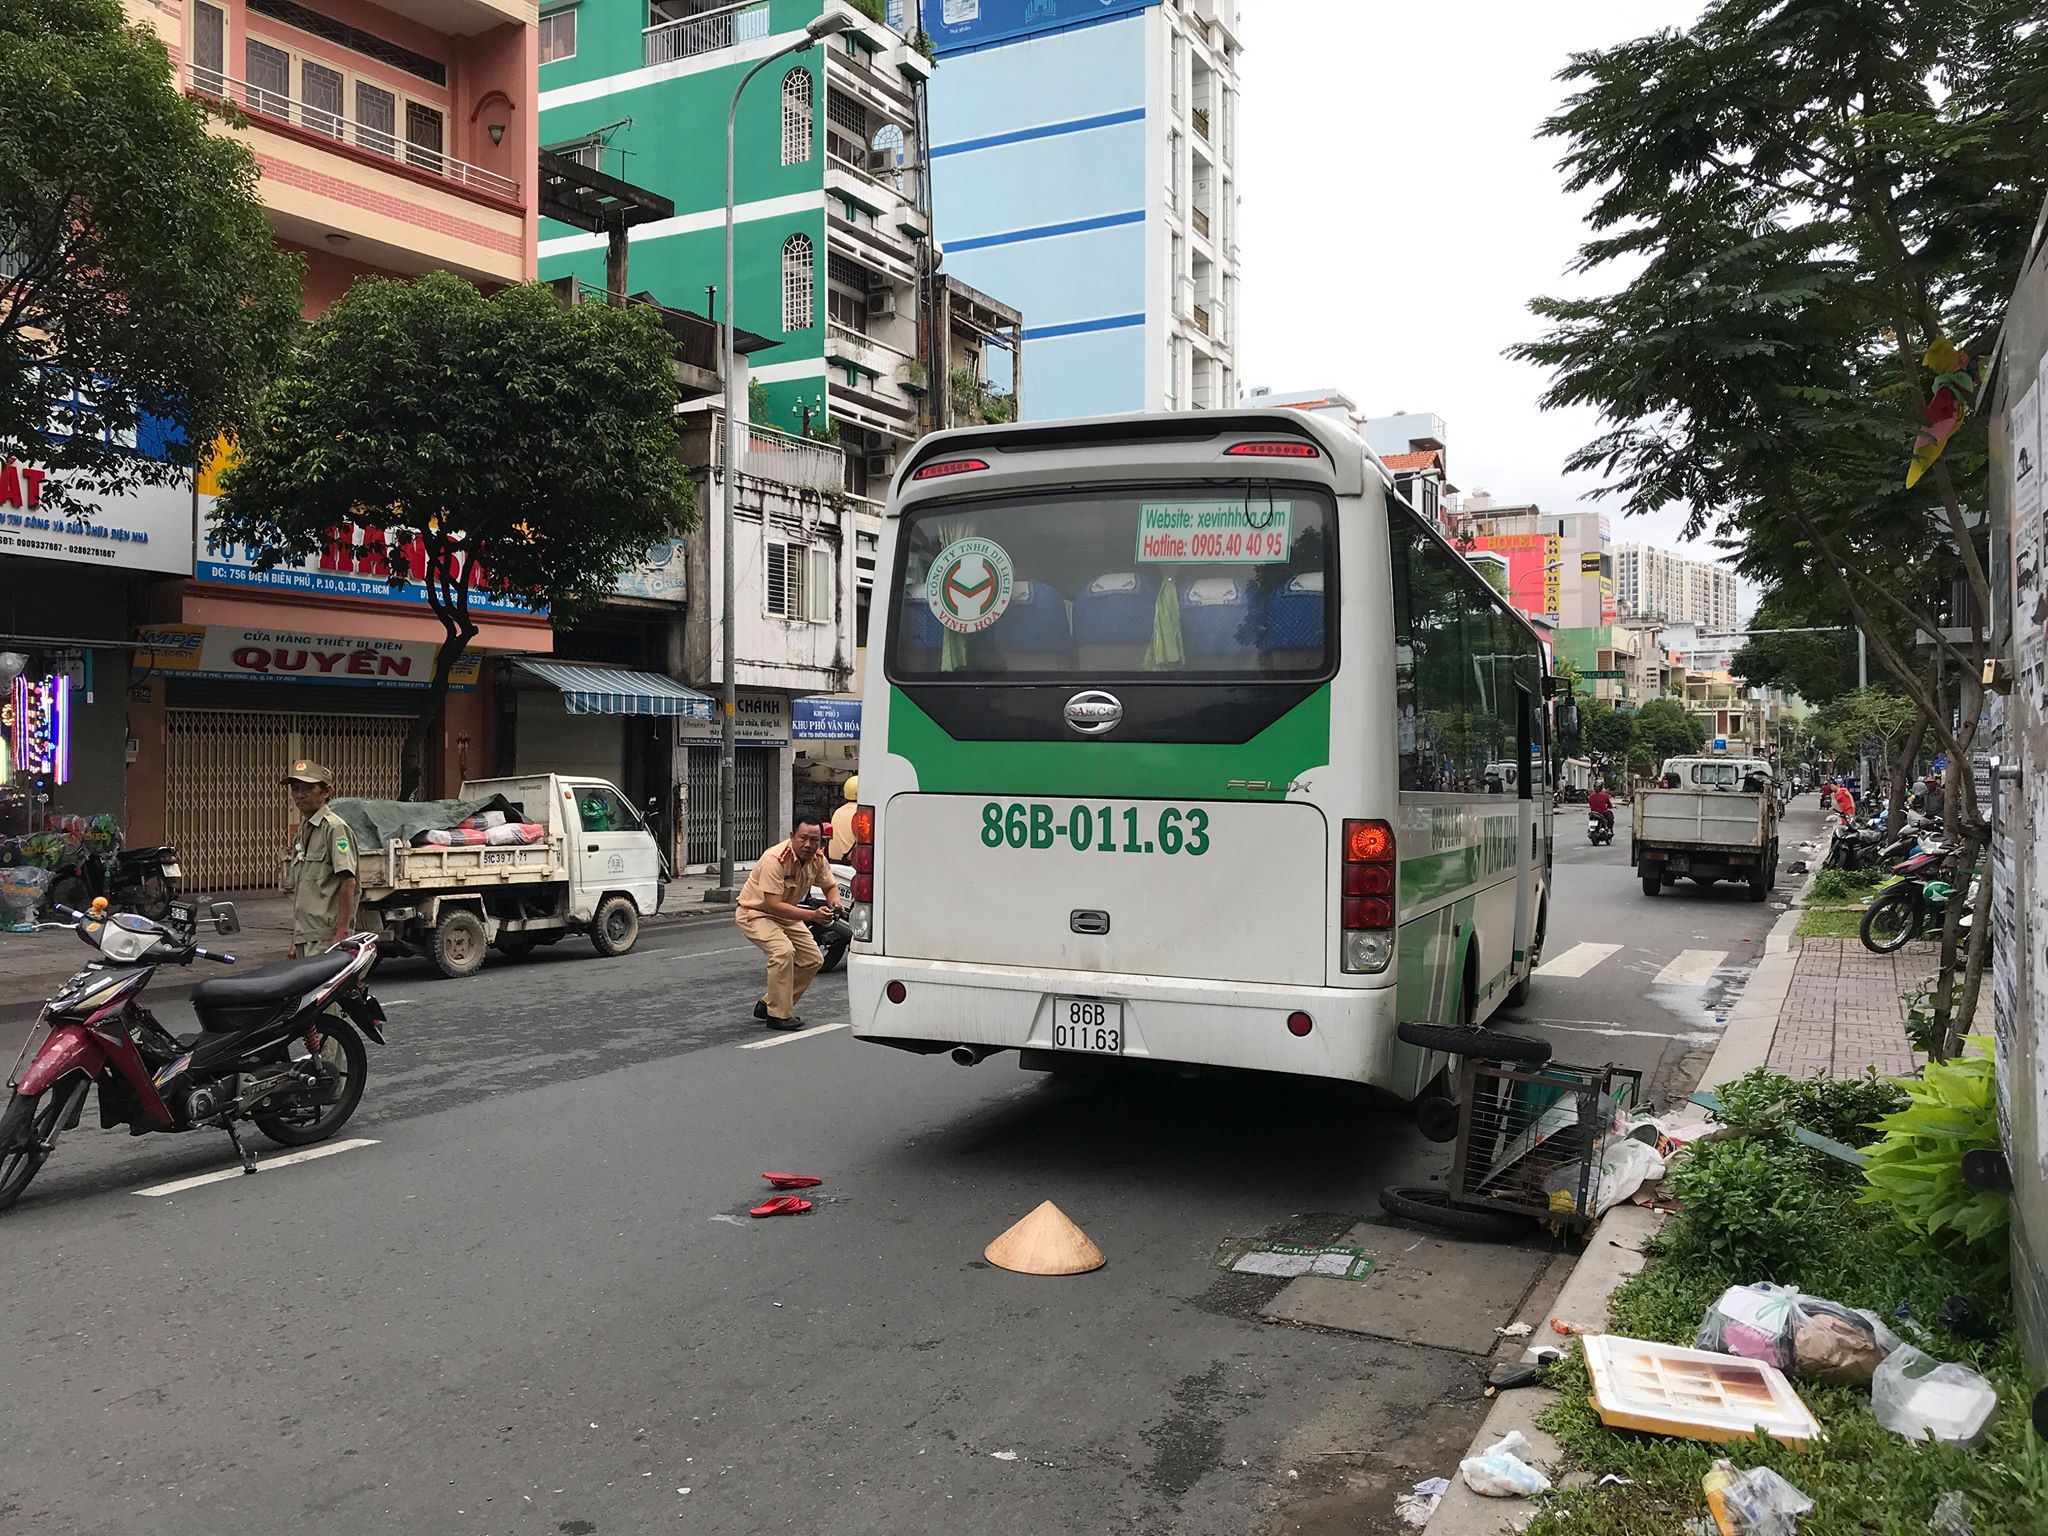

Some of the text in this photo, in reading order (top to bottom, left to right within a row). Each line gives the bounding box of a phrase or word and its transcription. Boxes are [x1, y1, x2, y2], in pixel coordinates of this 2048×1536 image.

[1146, 505, 1286, 529] Website: xevinhhoa.com
[25, 516, 50, 531] CÔNG
[53, 520, 64, 532] VÀ
[132, 531, 148, 544] NHÀ
[1143, 532, 1283, 557] Hotline: 0905.40 40 95
[1487, 535, 1536, 550] HOTEL
[211, 566, 227, 579] ĐC:
[230, 568, 246, 580] 756
[271, 572, 291, 585] BIÊN
[361, 582, 390, 596] TP.HCM
[929, 565, 944, 597] CÔNG
[943, 550, 956, 563] TY
[959, 543, 989, 554] TNHH
[990, 550, 1004, 565] DU
[244, 630, 271, 642] CỬA
[275, 632, 311, 645] HÀNG
[316, 635, 352, 648] THIẾT
[356, 641, 369, 651] BỊ
[232, 647, 411, 677] QUYỀN
[134, 689, 149, 698] 756
[737, 697, 780, 715] CHÁNH
[792, 718, 860, 731] KHU PHỐ VĂN HÓA
[1226, 779, 1313, 793] FELIX
[980, 802, 1210, 856] 86B-011.63
[1070, 1002, 1105, 1026] 86B
[1056, 1025, 1119, 1052] 011.63
